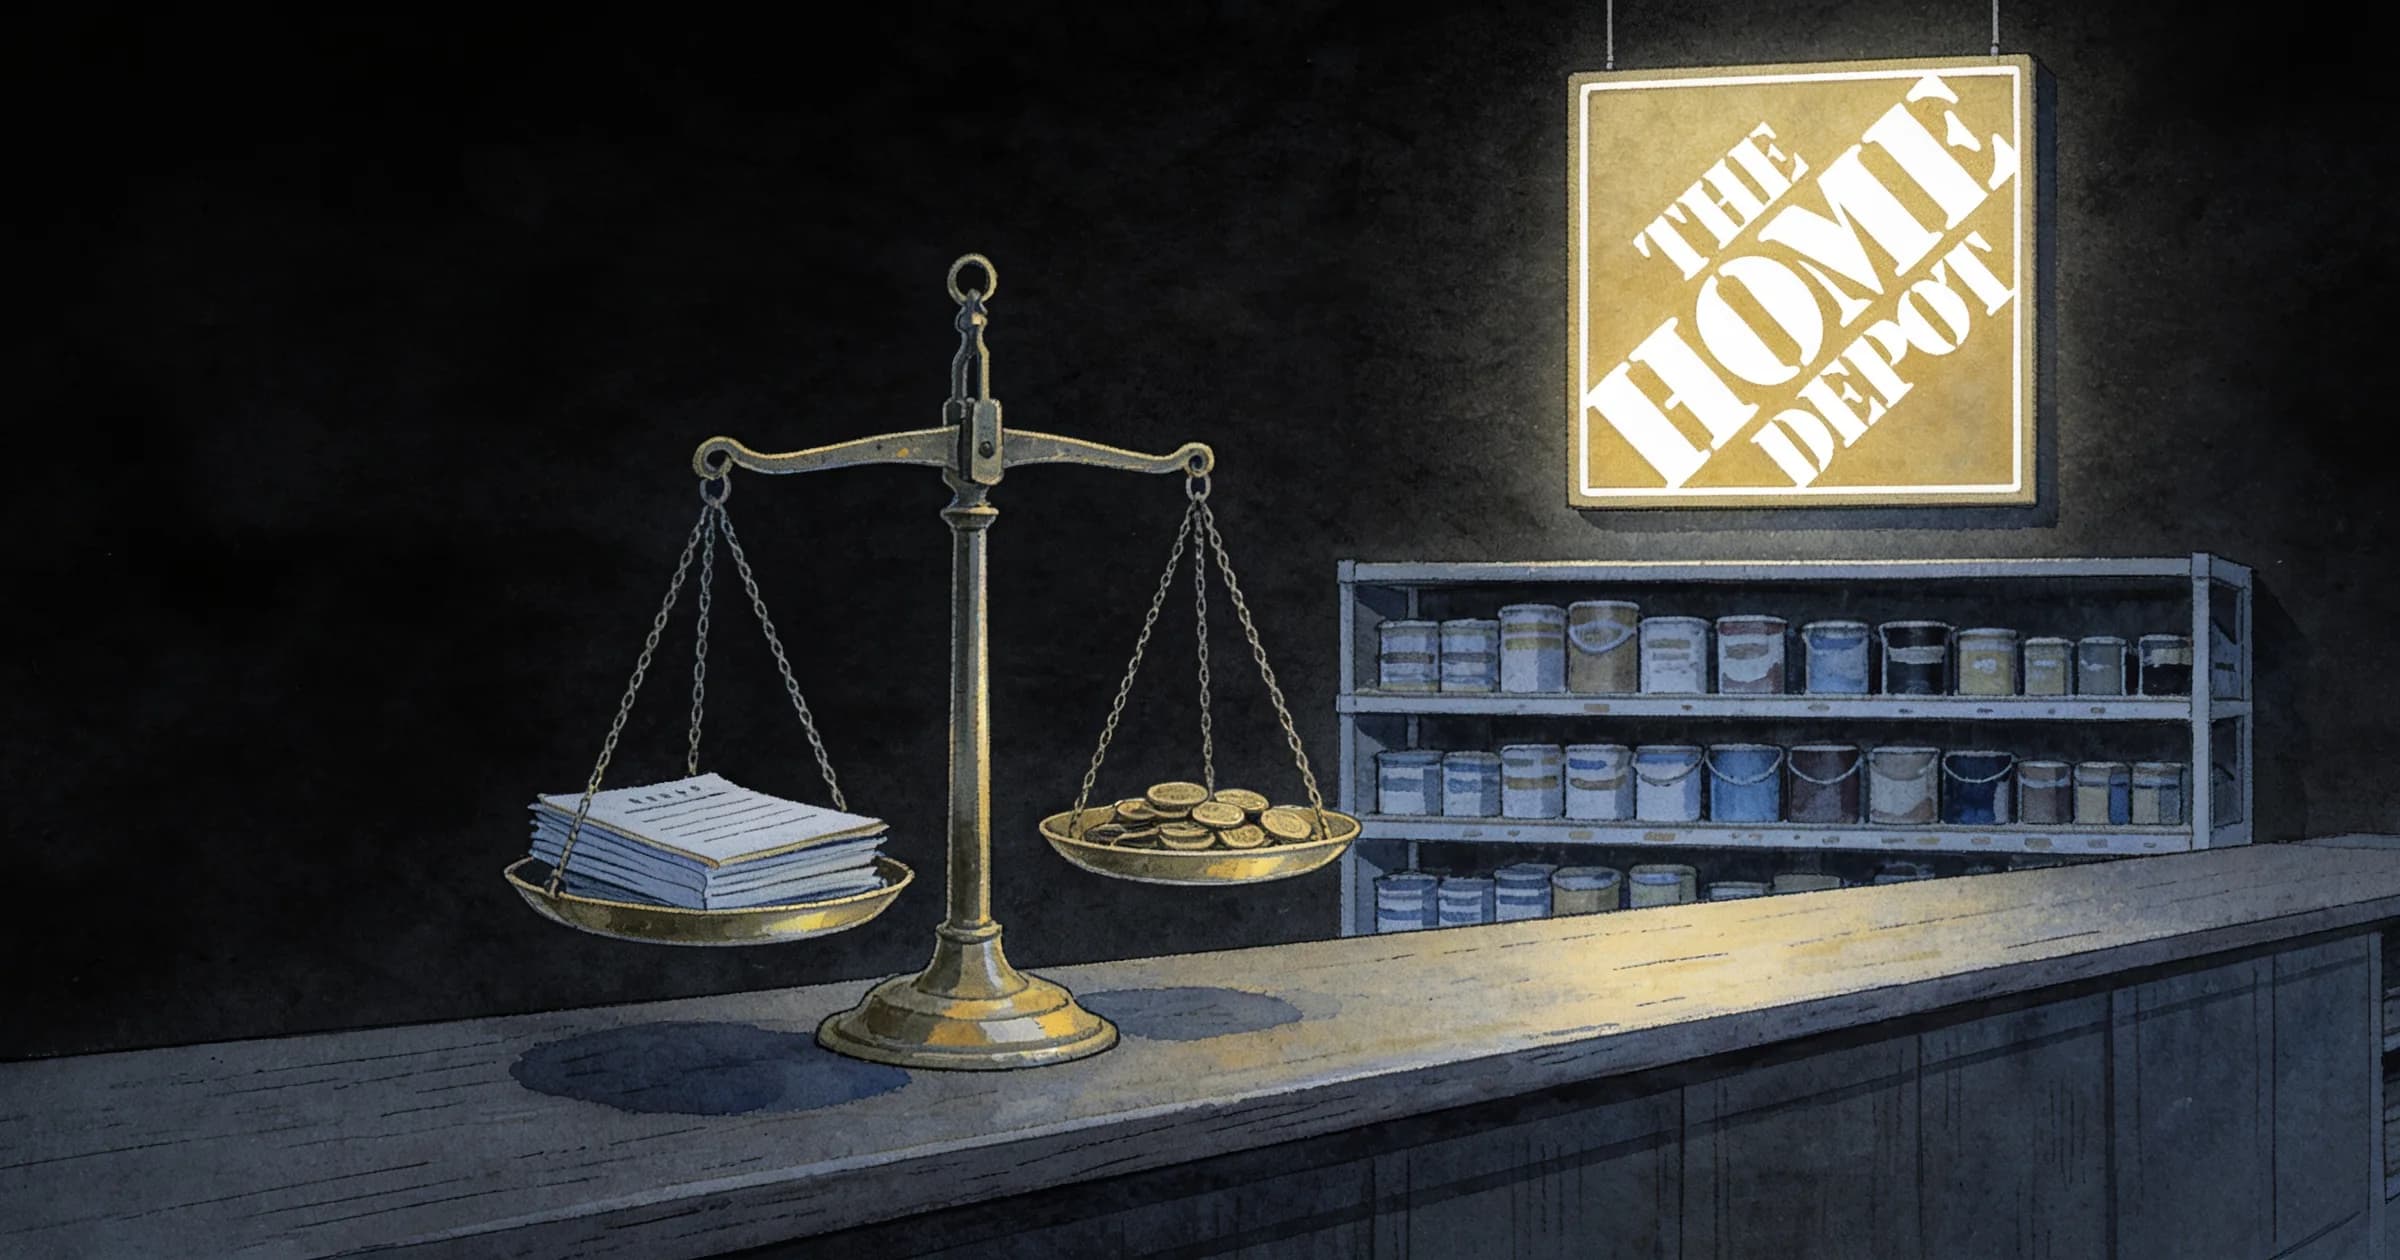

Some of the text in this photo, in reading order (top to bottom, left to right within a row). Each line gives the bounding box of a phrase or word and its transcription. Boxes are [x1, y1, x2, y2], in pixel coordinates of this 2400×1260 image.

[1587, 76, 2016, 489] HOME
[1633, 122, 1809, 281] THE
[1751, 231, 2016, 489] DEPOT
